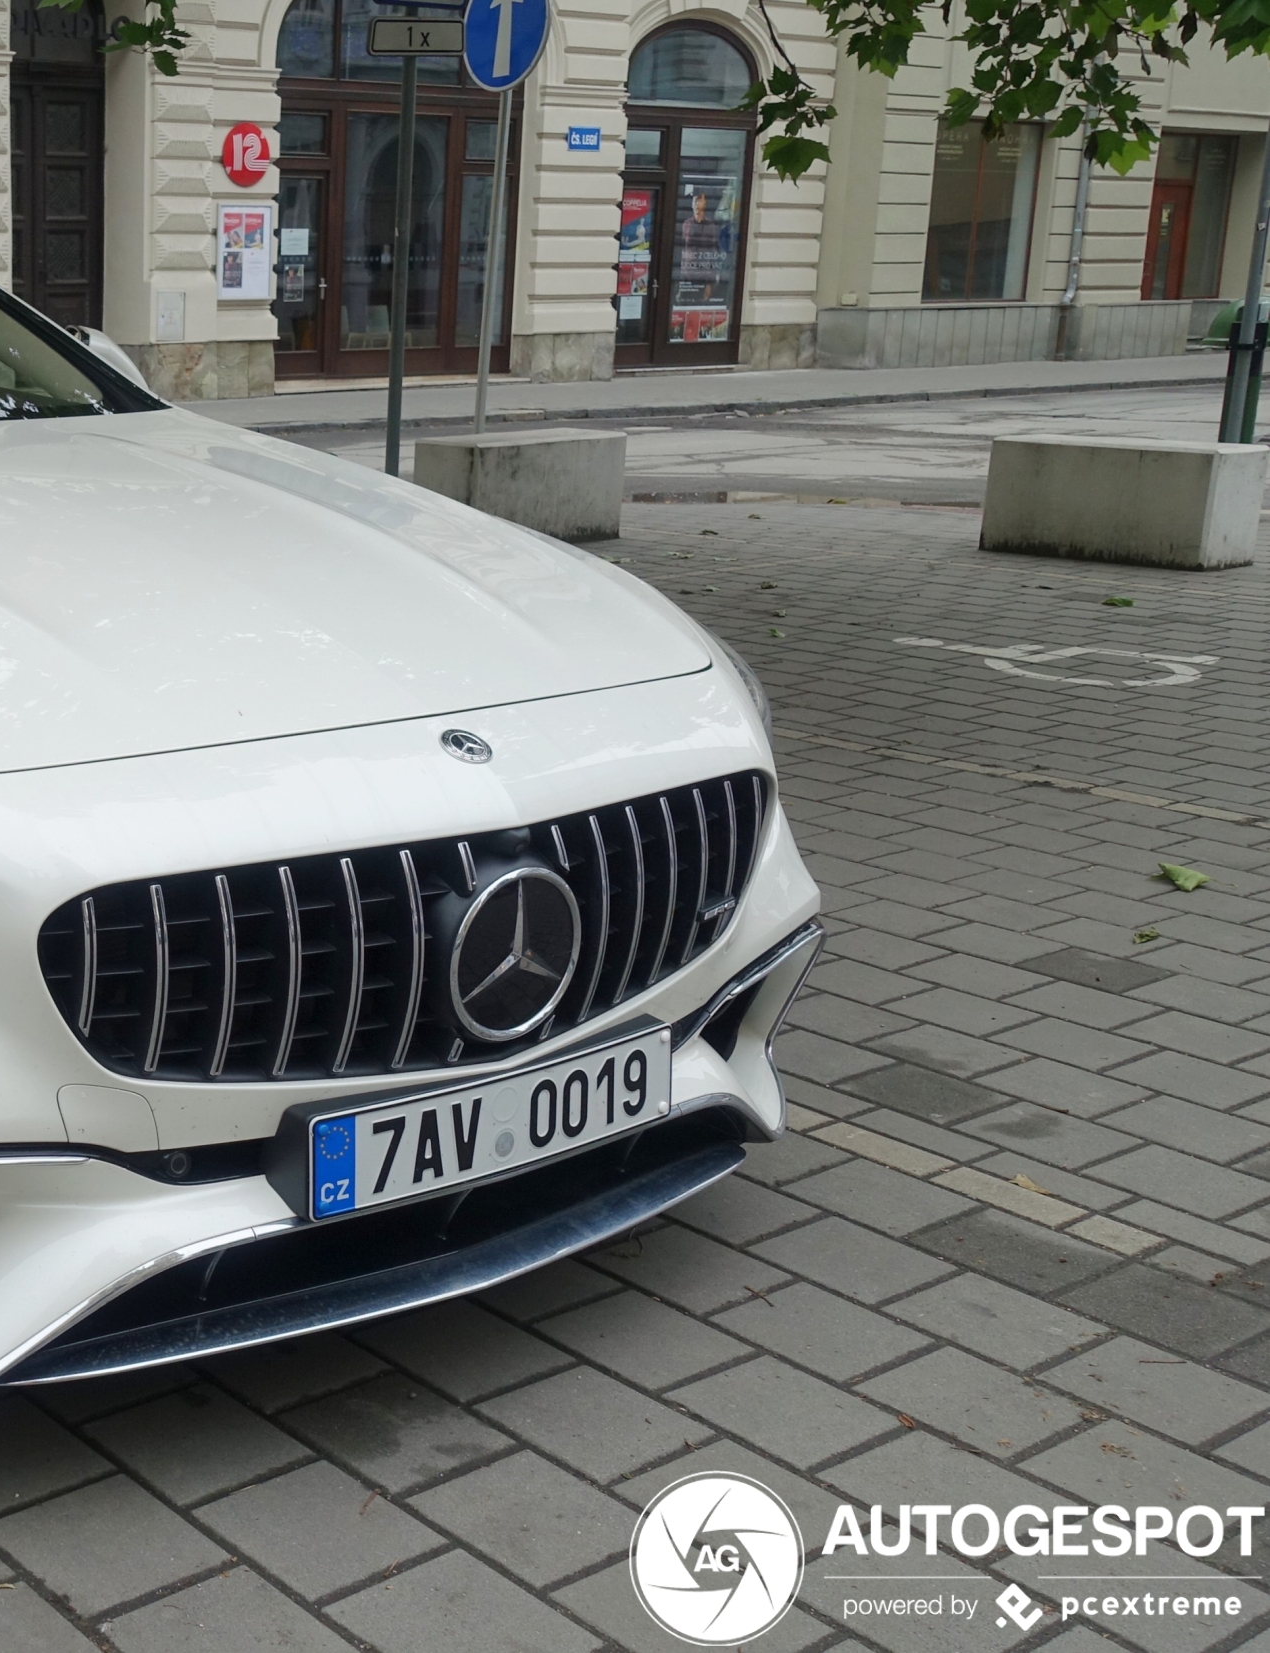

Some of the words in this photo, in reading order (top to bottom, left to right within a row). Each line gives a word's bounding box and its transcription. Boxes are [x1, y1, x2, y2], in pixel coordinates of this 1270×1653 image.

[407, 26, 413, 47] 1
[232, 133, 271, 172] 12
[372, 1097, 482, 1194] 7AV
[529, 1049, 647, 1148] 0019
[320, 1179, 350, 1203] CZ
